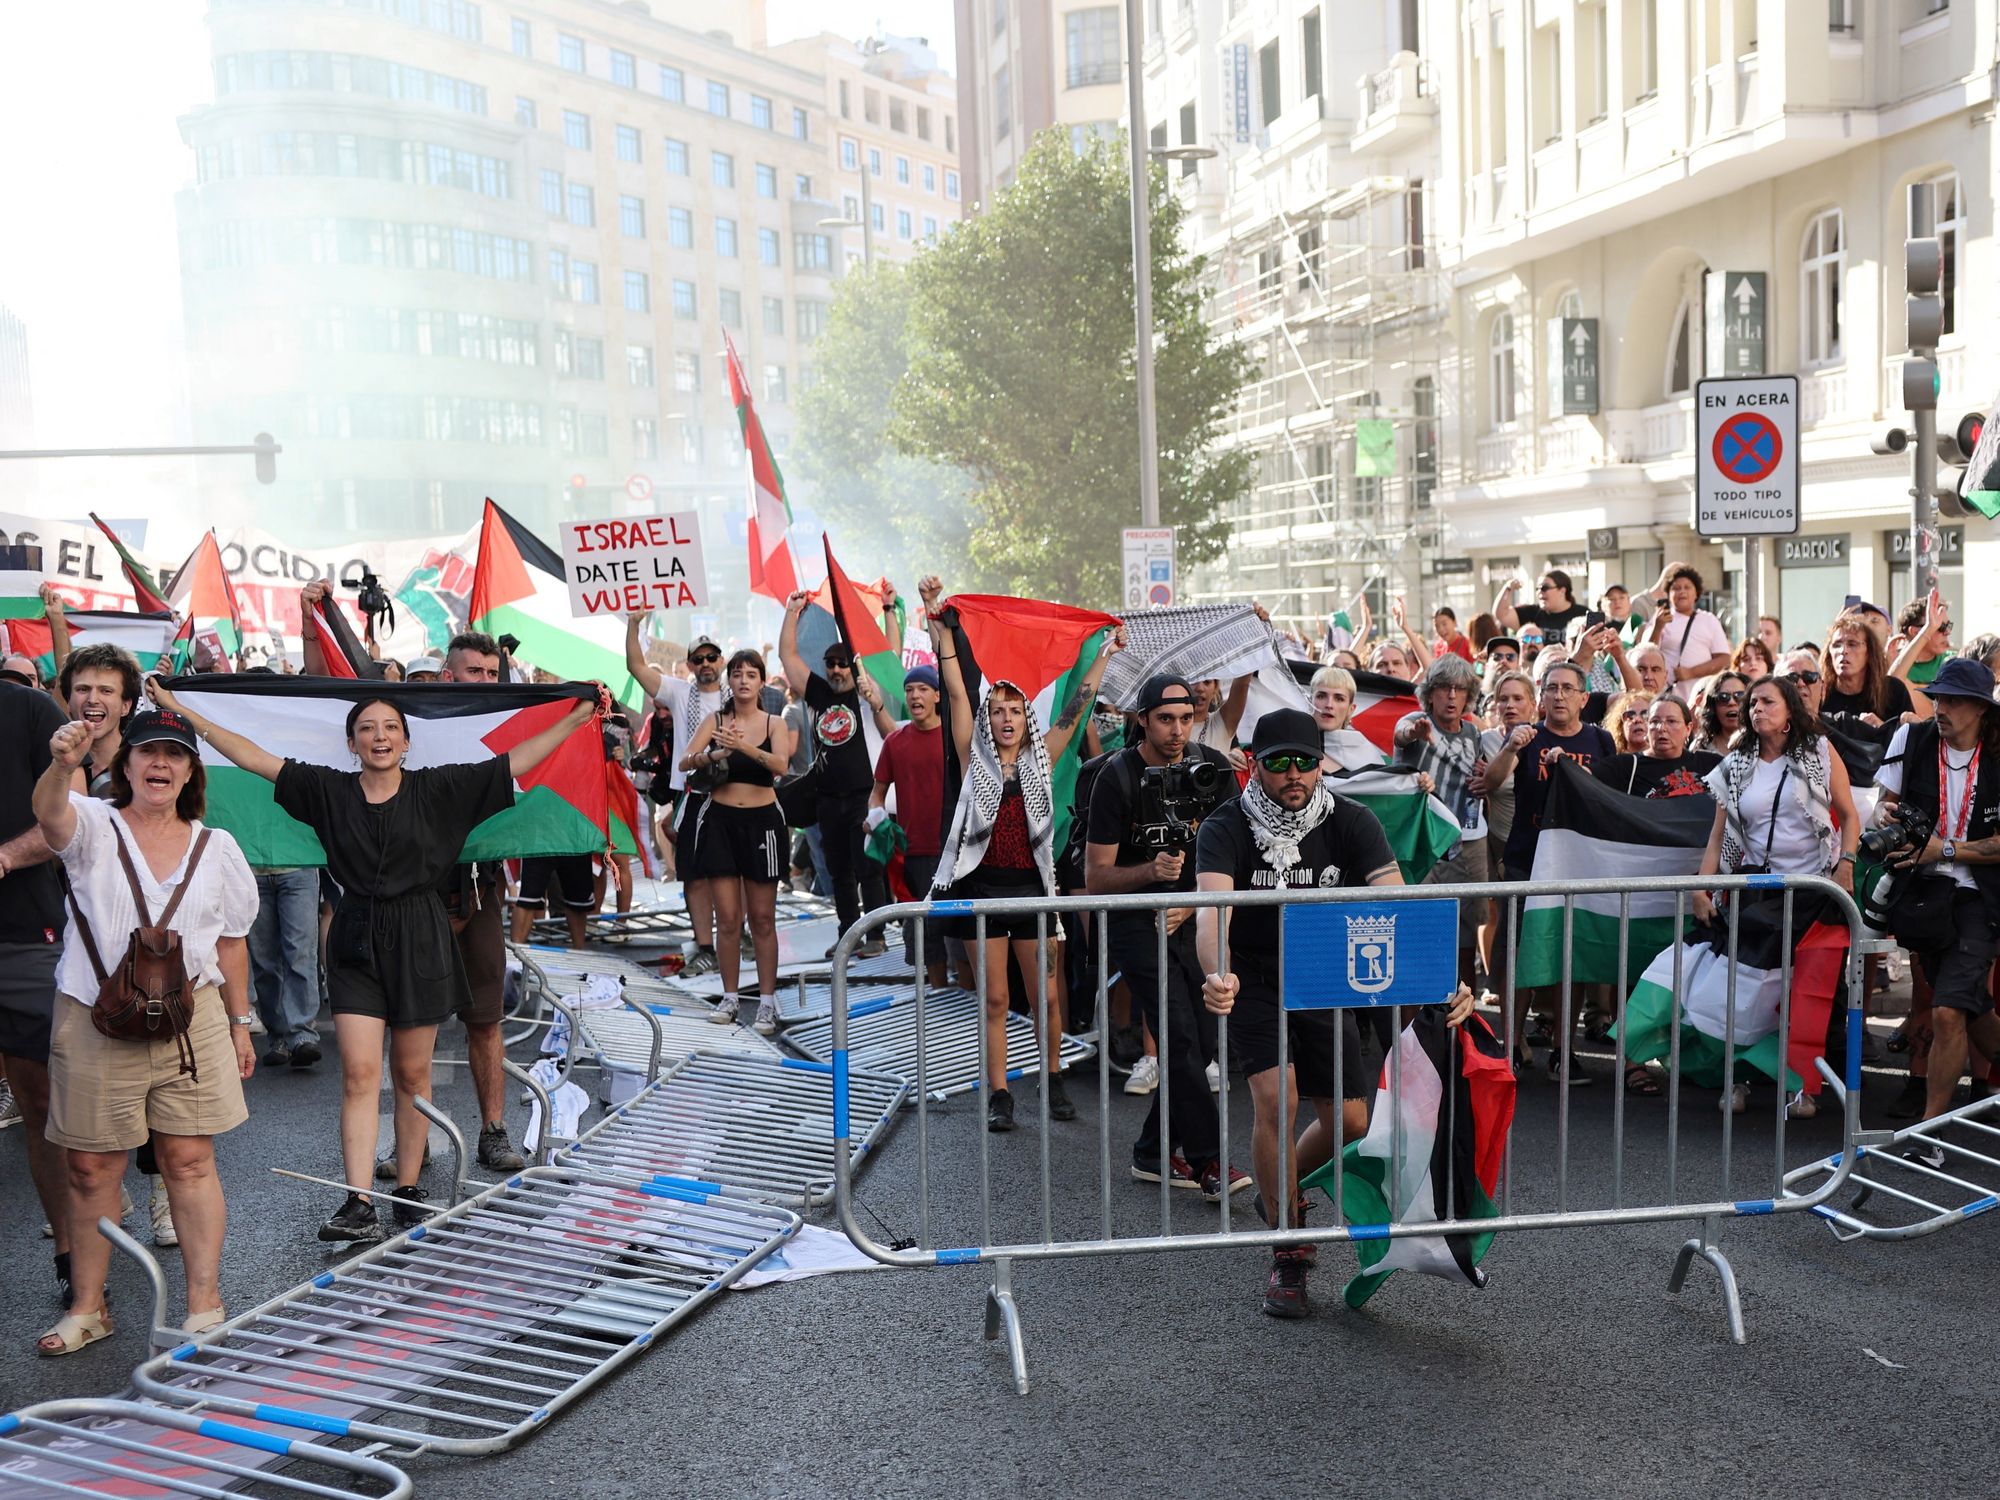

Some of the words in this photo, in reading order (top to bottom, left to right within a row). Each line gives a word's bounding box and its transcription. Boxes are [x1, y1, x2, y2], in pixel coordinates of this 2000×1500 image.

[1236, 45, 1247, 142] CONTINENTAL
[1705, 396, 1726, 407] EN
[1736, 393, 1790, 406] ACERA
[1714, 491, 1747, 500] TODO
[1755, 490, 1781, 499] TIPO
[1702, 511, 1717, 520] DE
[1724, 508, 1793, 519] VEHÍCULOS
[574, 517, 691, 552] ISRAEL
[1785, 540, 1841, 560] PARFOIS
[57, 539, 103, 581] EL
[576, 560, 639, 583] DATE
[654, 557, 685, 577] LA
[582, 581, 696, 613] VUELTA
[161, 711, 174, 719] NO
[160, 719, 188, 733] GUERRA
[1251, 867, 1313, 886] AUTOGSTIÓN
